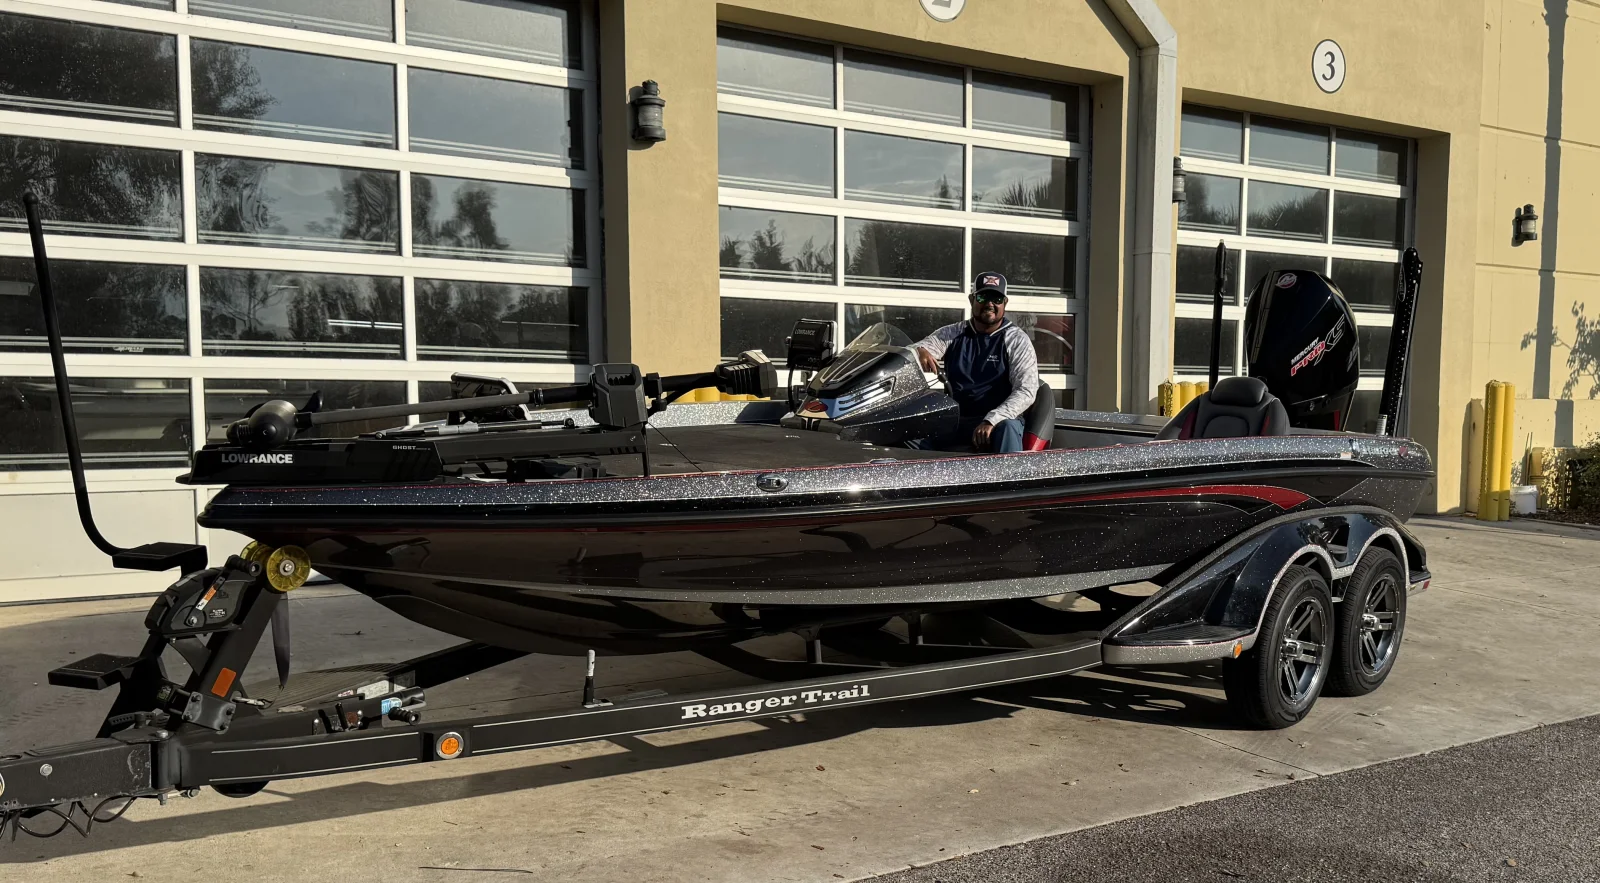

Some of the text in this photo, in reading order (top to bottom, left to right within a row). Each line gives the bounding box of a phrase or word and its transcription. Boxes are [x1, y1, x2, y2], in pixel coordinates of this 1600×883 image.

[1322, 51, 1335, 81] 3
[1291, 336, 1319, 365] MERCURY
[1291, 340, 1326, 376] PRO
[221, 453, 293, 464] LOWRANCE
[681, 685, 870, 719] Ranger Trail
